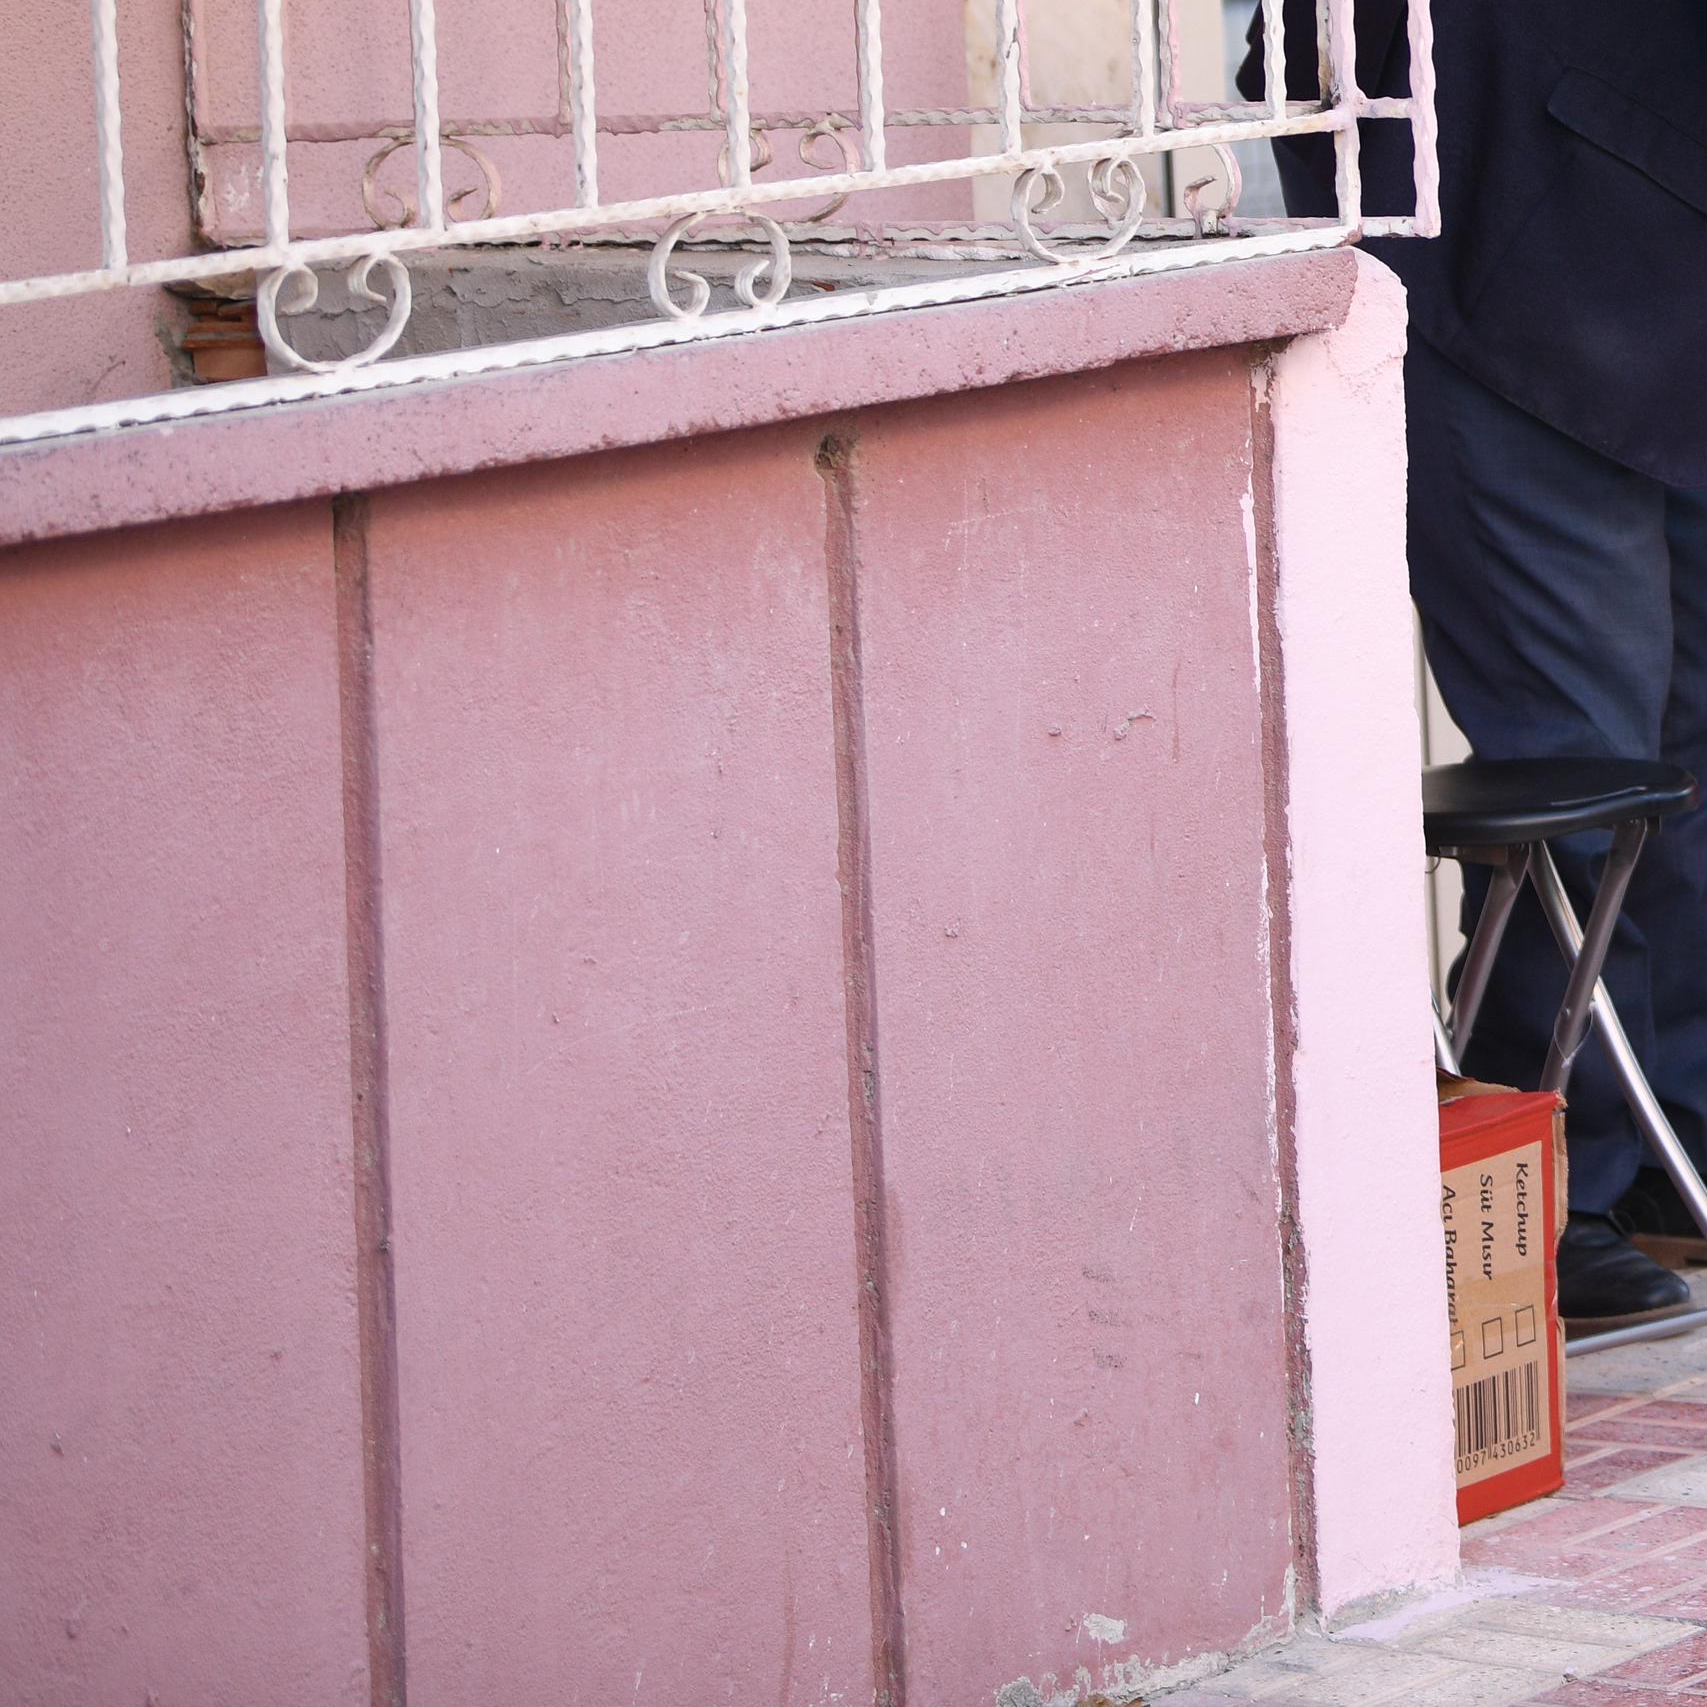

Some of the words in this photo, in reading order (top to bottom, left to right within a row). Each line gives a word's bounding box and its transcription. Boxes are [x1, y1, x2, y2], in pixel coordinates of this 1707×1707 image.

[1480, 1173, 1493, 1214] Süt
[1515, 1162, 1529, 1257] Ketchup
[1481, 1220, 1495, 1281] Mısır
[1491, 1431, 1537, 1461] 430632
